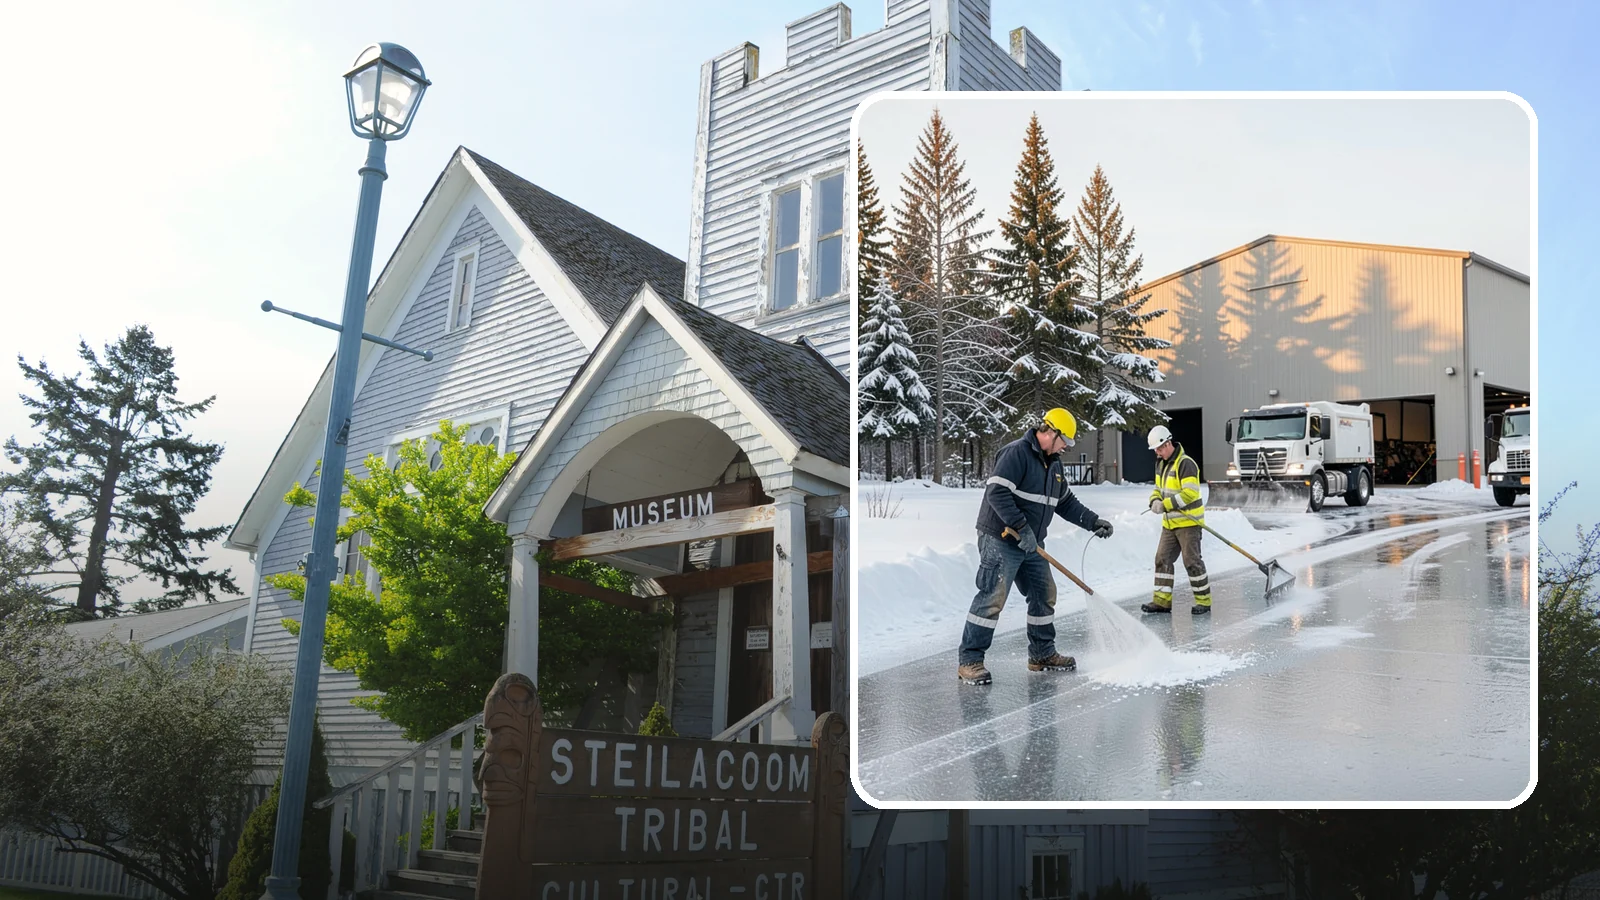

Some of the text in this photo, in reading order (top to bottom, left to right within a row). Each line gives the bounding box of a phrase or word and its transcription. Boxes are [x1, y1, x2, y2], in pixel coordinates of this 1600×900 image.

[613, 491, 714, 531] MUSEUM
[550, 738, 809, 793] STEILACOOM
[613, 806, 758, 852] TRIBAL
[755, 872, 805, 900] CTR
